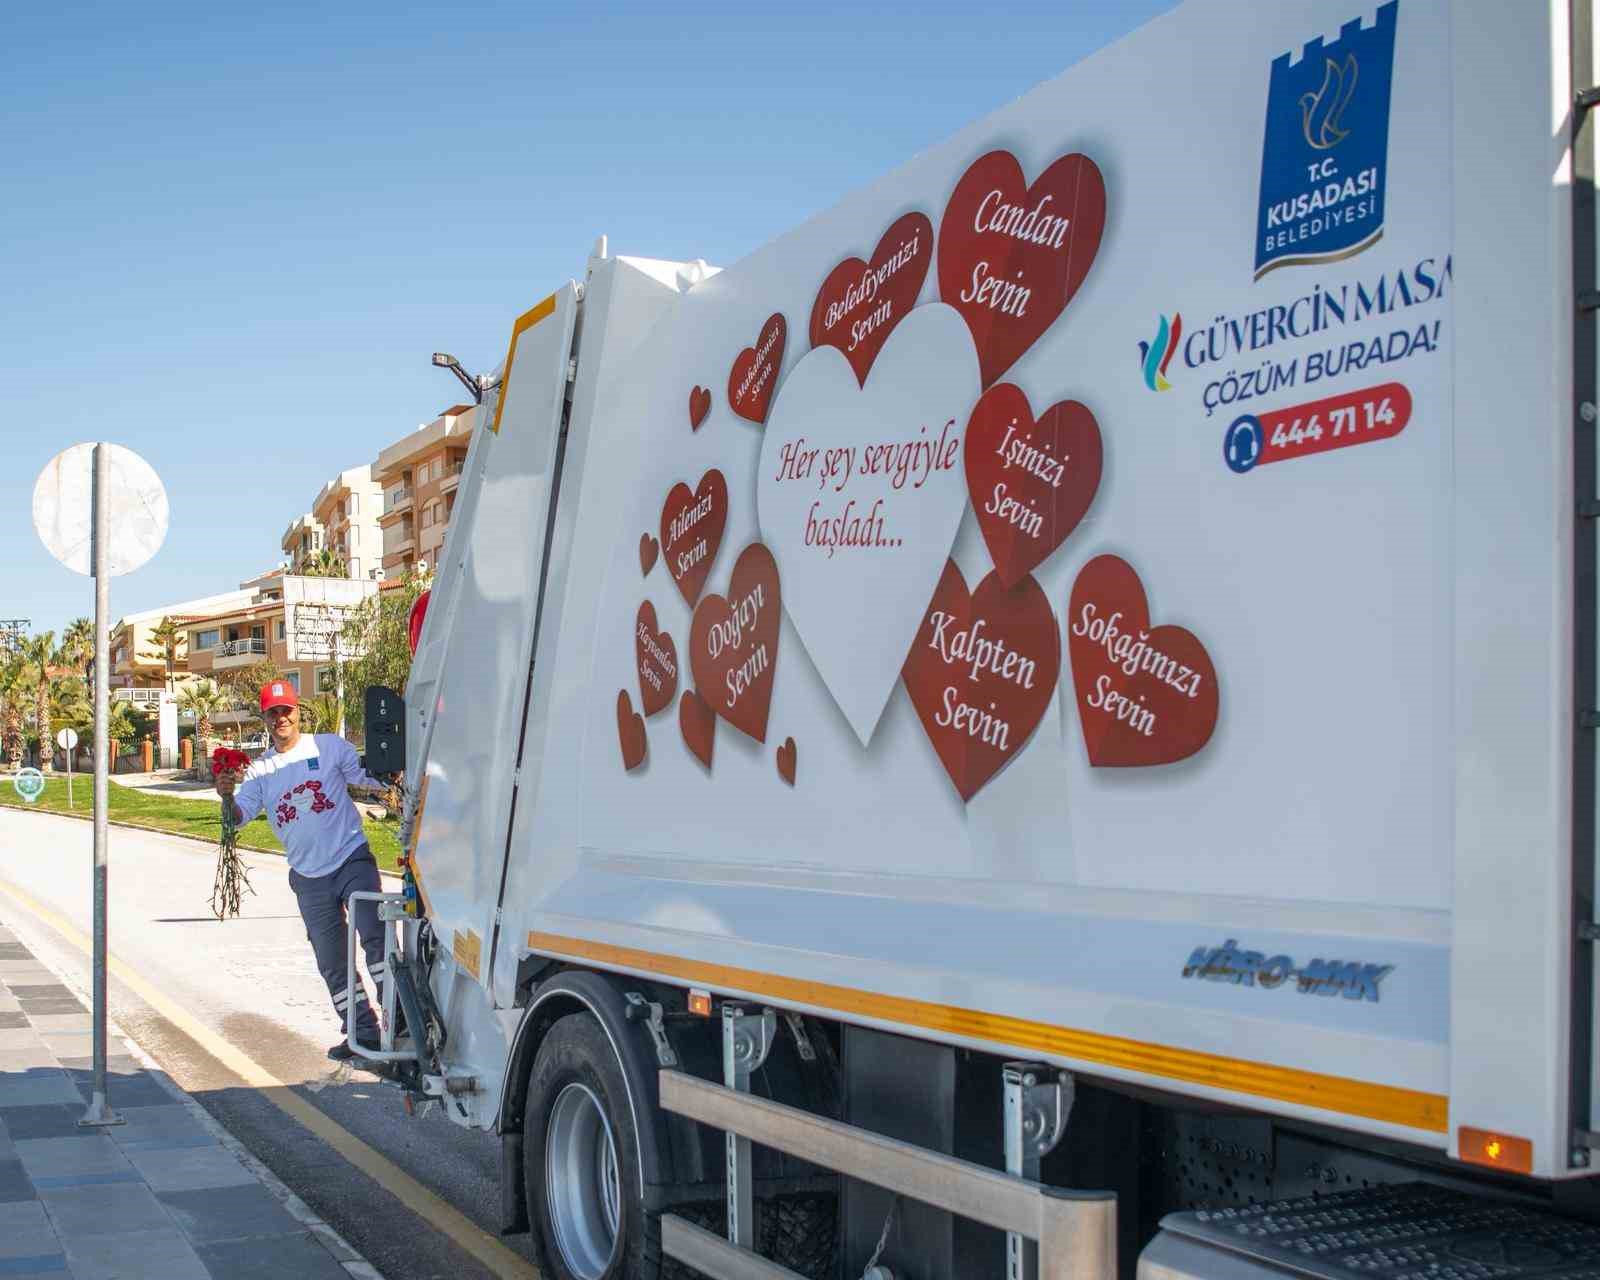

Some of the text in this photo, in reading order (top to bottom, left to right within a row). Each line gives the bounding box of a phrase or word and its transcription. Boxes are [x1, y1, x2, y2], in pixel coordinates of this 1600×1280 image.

[1308, 158, 1338, 182] T.C.
[974, 190, 1069, 248] Candan
[1265, 195, 1376, 251] BELEDİYESİ
[824, 228, 920, 330] Belediyenizi
[960, 262, 1031, 317] Sevin
[848, 300, 892, 351] Sevin
[751, 362, 772, 402] Sevin
[1203, 320, 1440, 417] ÇÖZÜM BURADA!
[995, 418, 1070, 488] İşinizi
[1270, 398, 1395, 448] 444 71 14
[776, 419, 959, 492] Her şey sevgiyle
[666, 486, 713, 551] Ailenizi
[804, 499, 902, 559] başladı...
[984, 483, 1044, 538] Sevin
[676, 537, 708, 580] Sevin
[708, 583, 764, 660] Doğayı
[929, 611, 1036, 690] Kalpten
[1073, 603, 1202, 699] Sokağınızı
[640, 658, 662, 692] Sevin
[727, 643, 769, 708] Sevin
[935, 686, 1010, 751] Sevin
[1087, 675, 1157, 736] Sevin
